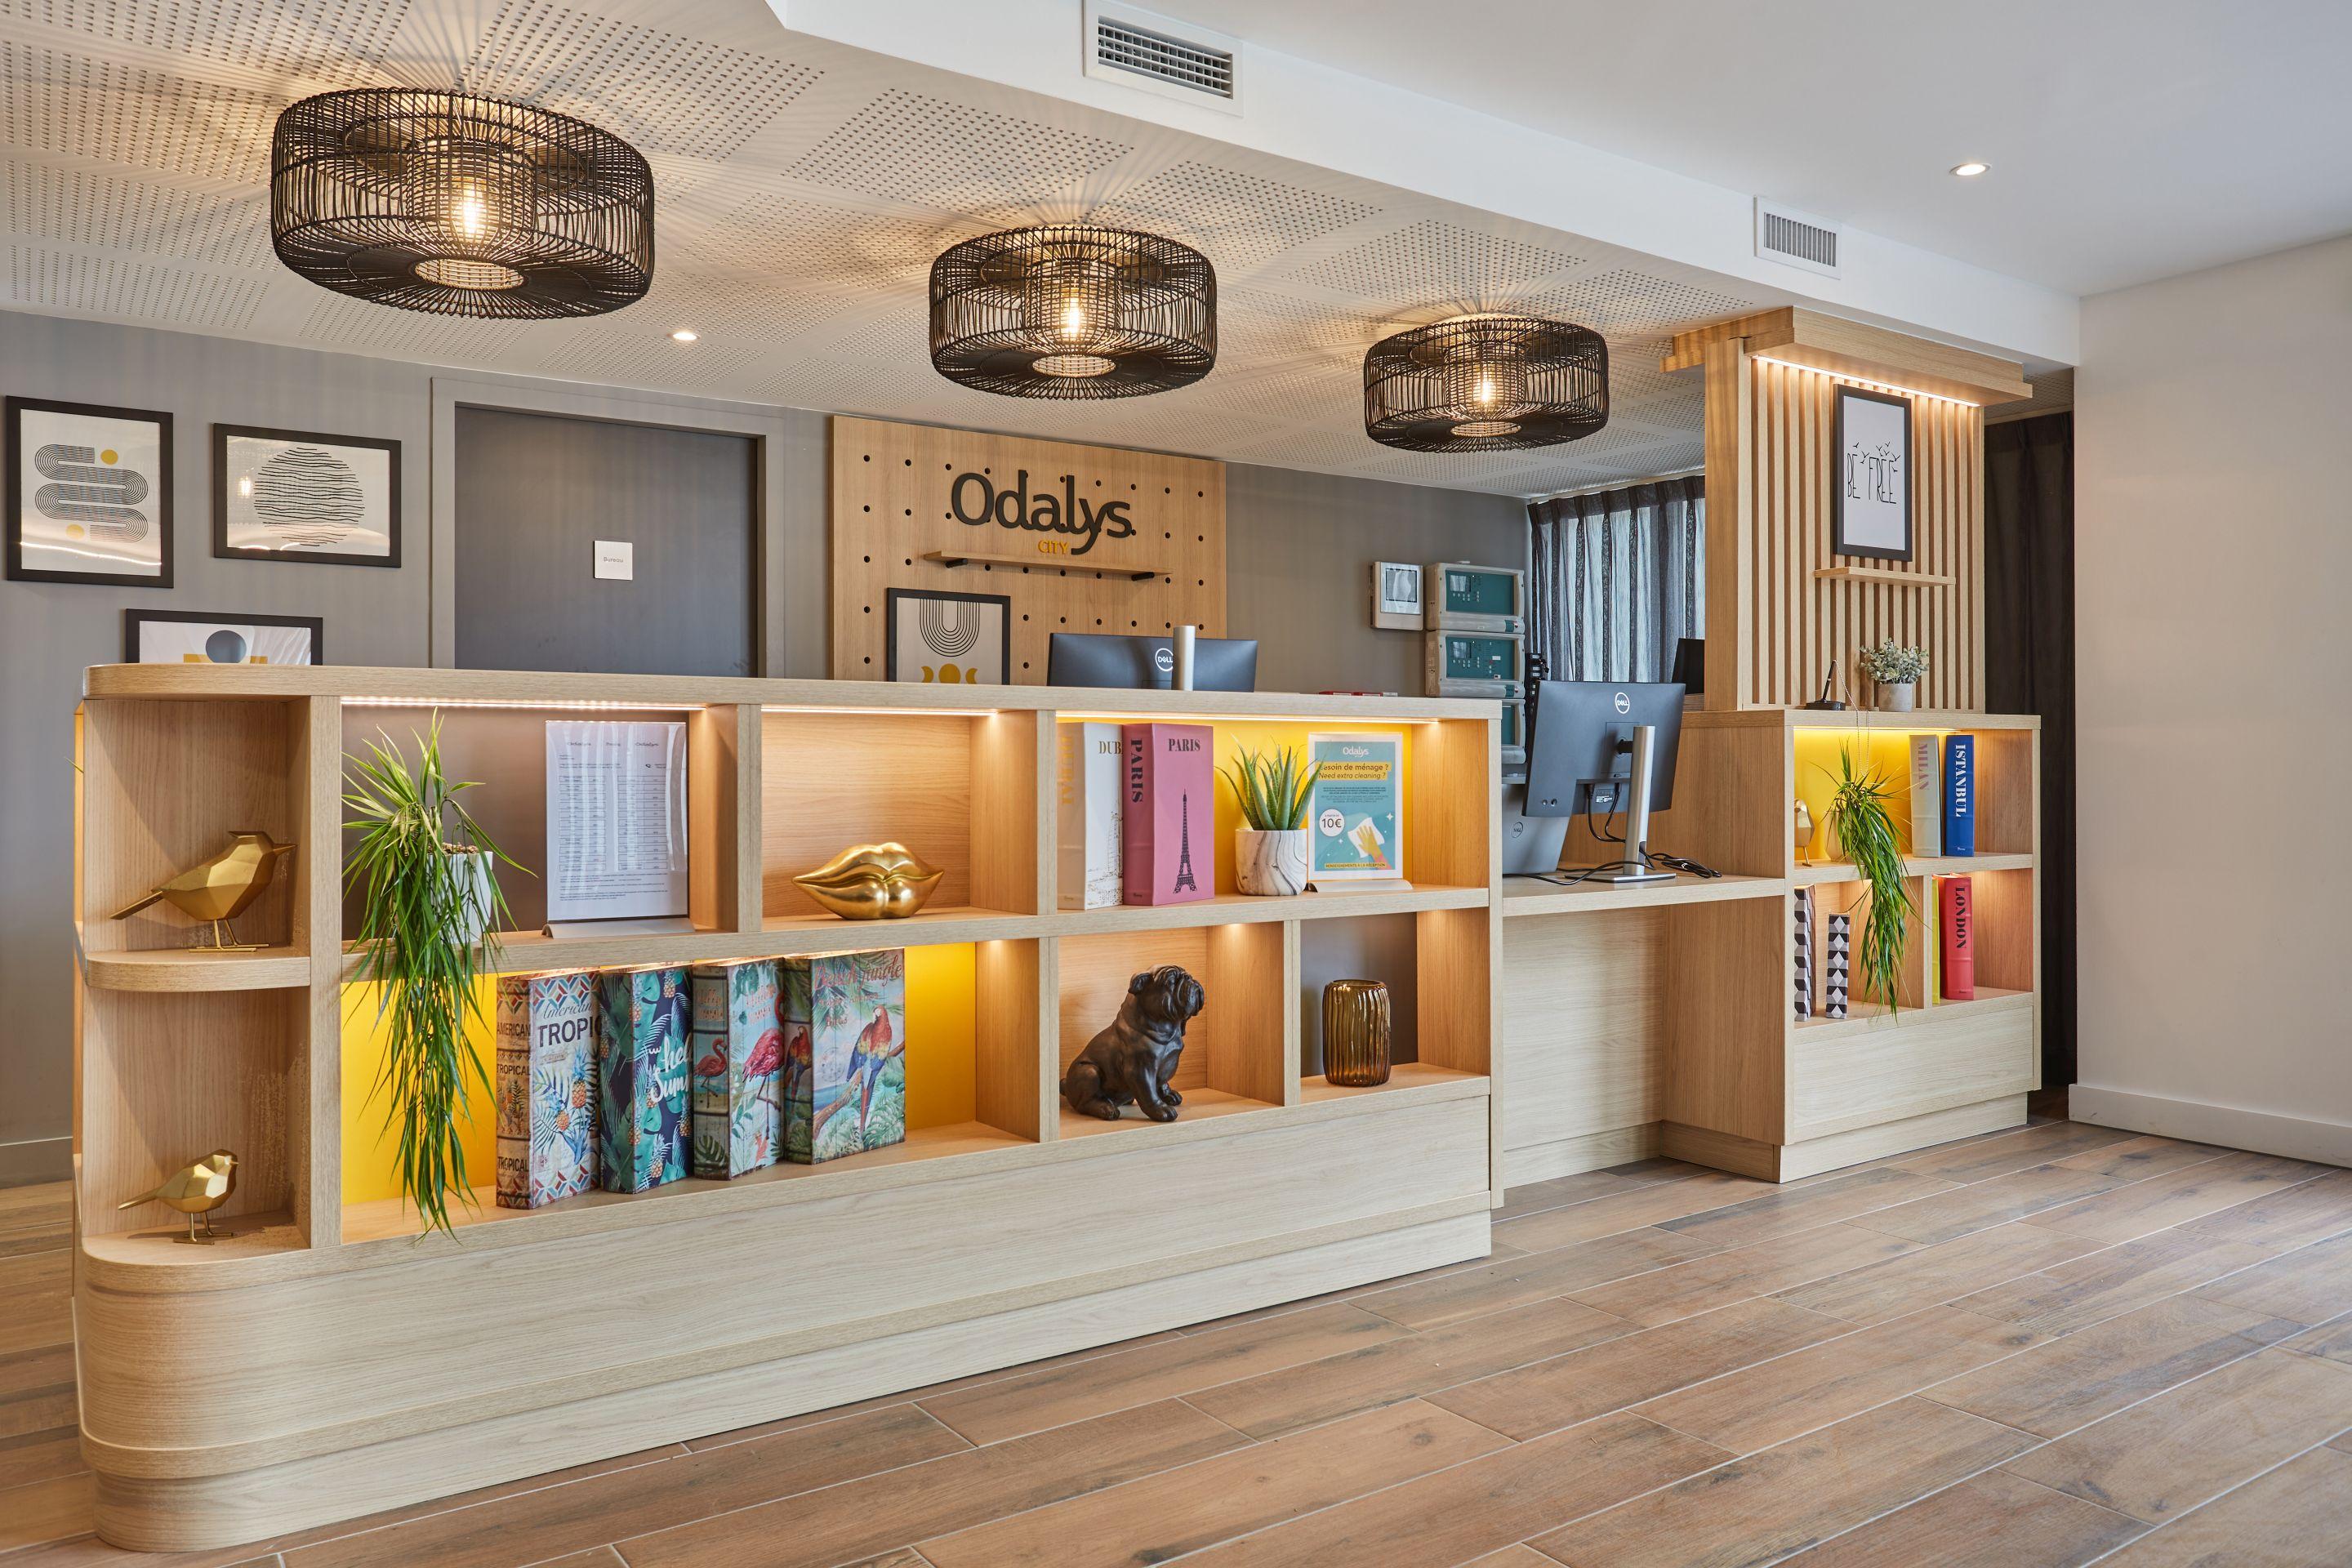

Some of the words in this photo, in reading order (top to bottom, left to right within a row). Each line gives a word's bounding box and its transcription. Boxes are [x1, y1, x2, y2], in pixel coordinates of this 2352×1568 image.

[951, 470, 1134, 555] Odalys
[1038, 540, 1068, 555] CITY
[1098, 741, 1124, 755] DUB
[1168, 738, 1200, 752] PARIS
[1343, 746, 1370, 758] Odalys
[1130, 739, 1143, 804] PARIS
[1355, 764, 1383, 772] ménage
[1918, 742, 1930, 791] MILAN
[1354, 772, 1381, 780] cleaning
[1955, 744, 1967, 817] ISTANBUL
[1321, 818, 1342, 828] 10€
[1955, 887, 1967, 948] LONDON
[497, 1022, 531, 1036] AMERICAN
[537, 1015, 602, 1047] TROPIC
[663, 1032, 693, 1073] hel
[497, 1063, 531, 1076] TROPICAL
[650, 1067, 688, 1102] Sum
[497, 1156, 529, 1172] TROPICAL
